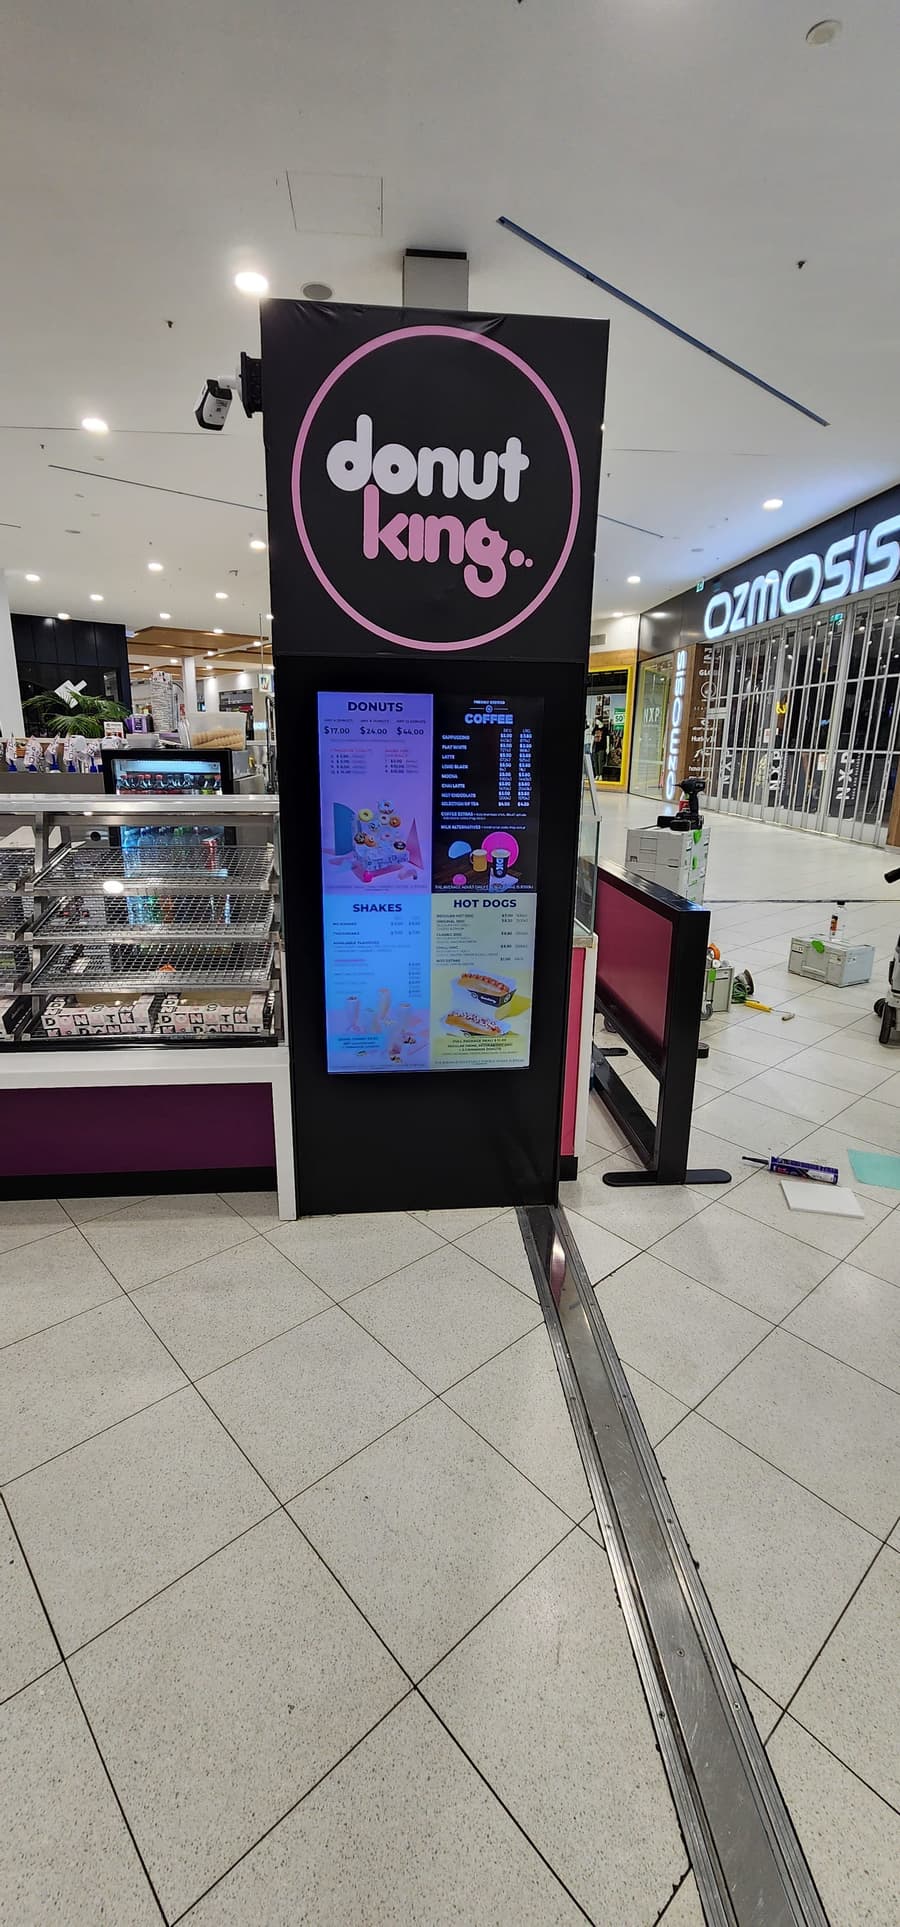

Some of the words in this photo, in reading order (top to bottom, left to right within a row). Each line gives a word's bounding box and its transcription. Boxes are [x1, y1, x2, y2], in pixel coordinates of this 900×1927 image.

[326, 414, 530, 502] donut
[704, 515, 900, 639] OZMOSIS
[348, 702, 404, 712] DONUTS
[465, 714, 513, 724] COFFEE
[324, 725, 350, 735] $17.00
[835, 751, 854, 800] NXP
[353, 904, 402, 912] SHAKES
[454, 900, 479, 908] HOT
[483, 900, 517, 908] DOGS
